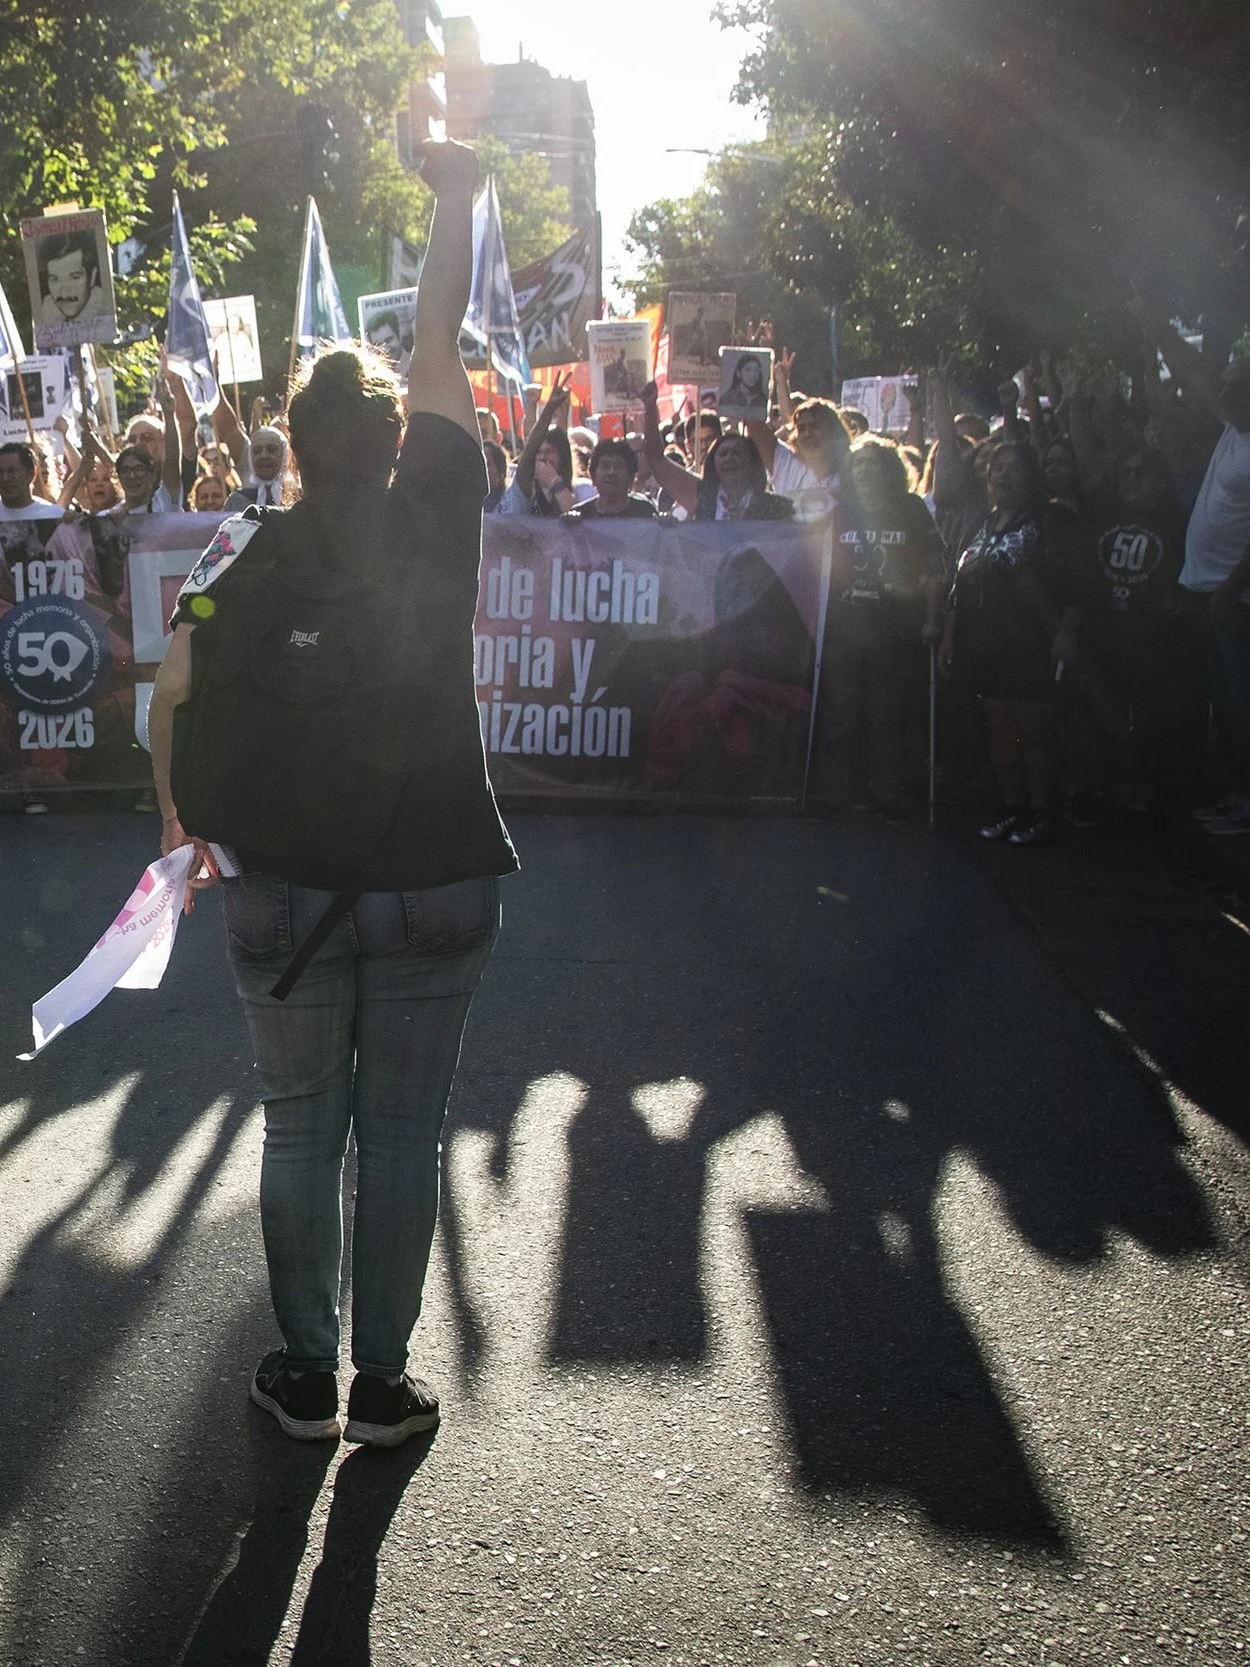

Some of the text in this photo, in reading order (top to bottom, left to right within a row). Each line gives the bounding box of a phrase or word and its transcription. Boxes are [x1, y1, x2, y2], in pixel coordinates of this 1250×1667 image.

[365, 295, 413, 309] PRESENTE
[1110, 531, 1149, 571] 50
[10, 559, 86, 603] 1976
[486, 556, 659, 625] de lucha
[7, 627, 16, 638] de
[14, 609, 35, 627] lucha
[35, 605, 73, 617] memoria
[474, 624, 595, 704] oria y
[18, 706, 95, 750] 2026
